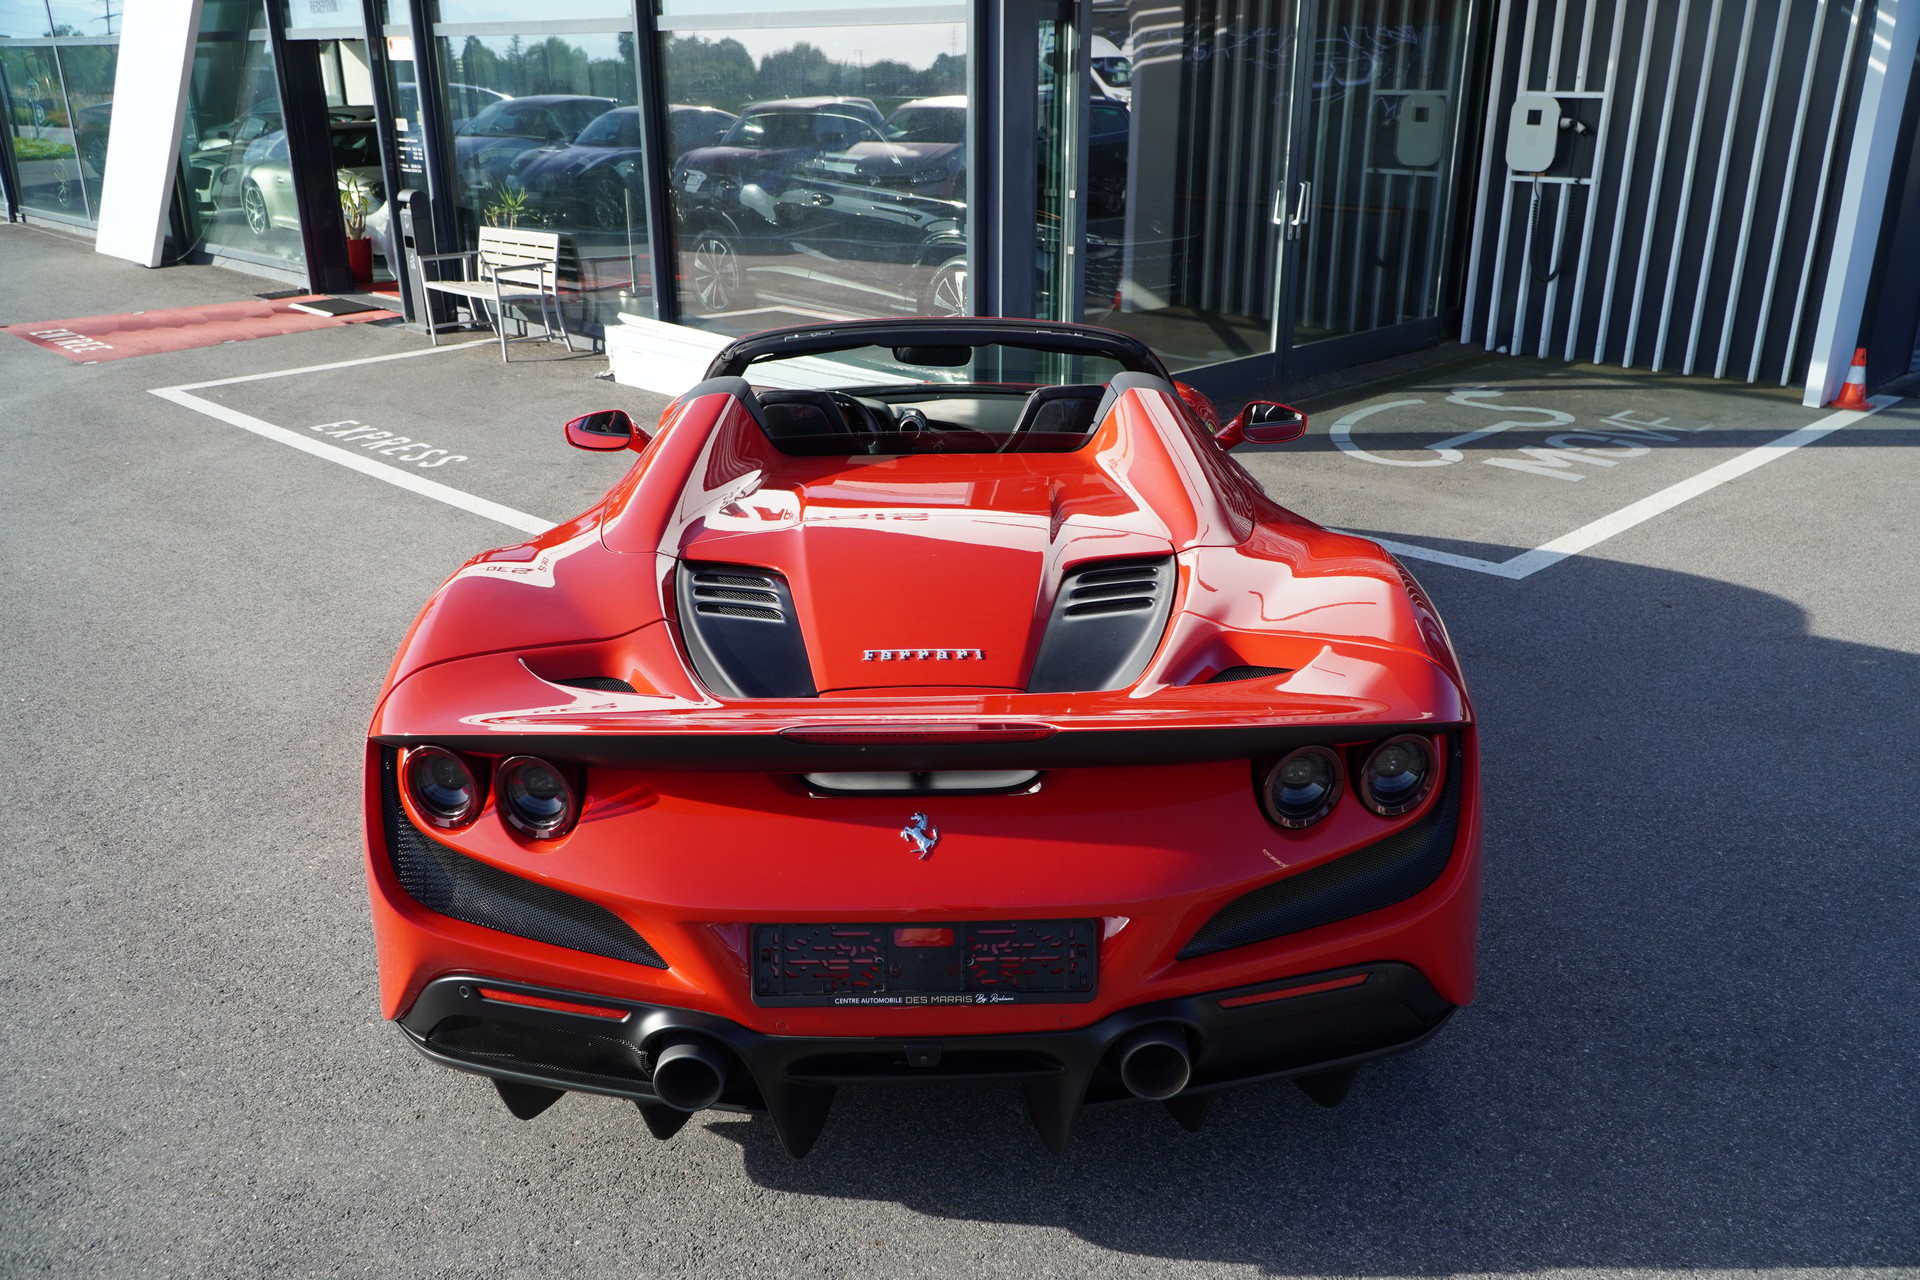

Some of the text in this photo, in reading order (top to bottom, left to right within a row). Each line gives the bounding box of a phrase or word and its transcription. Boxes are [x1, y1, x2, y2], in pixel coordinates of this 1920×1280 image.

[29, 328, 114, 354] ENTREE
[309, 419, 469, 468] EXPRESS
[861, 648, 985, 662] Ferrari
[834, 997, 860, 1005] CENTRE
[860, 996, 903, 1004] AUTOMOBILE
[905, 996, 928, 1004] DES
[930, 995, 973, 1004] MARAIS
